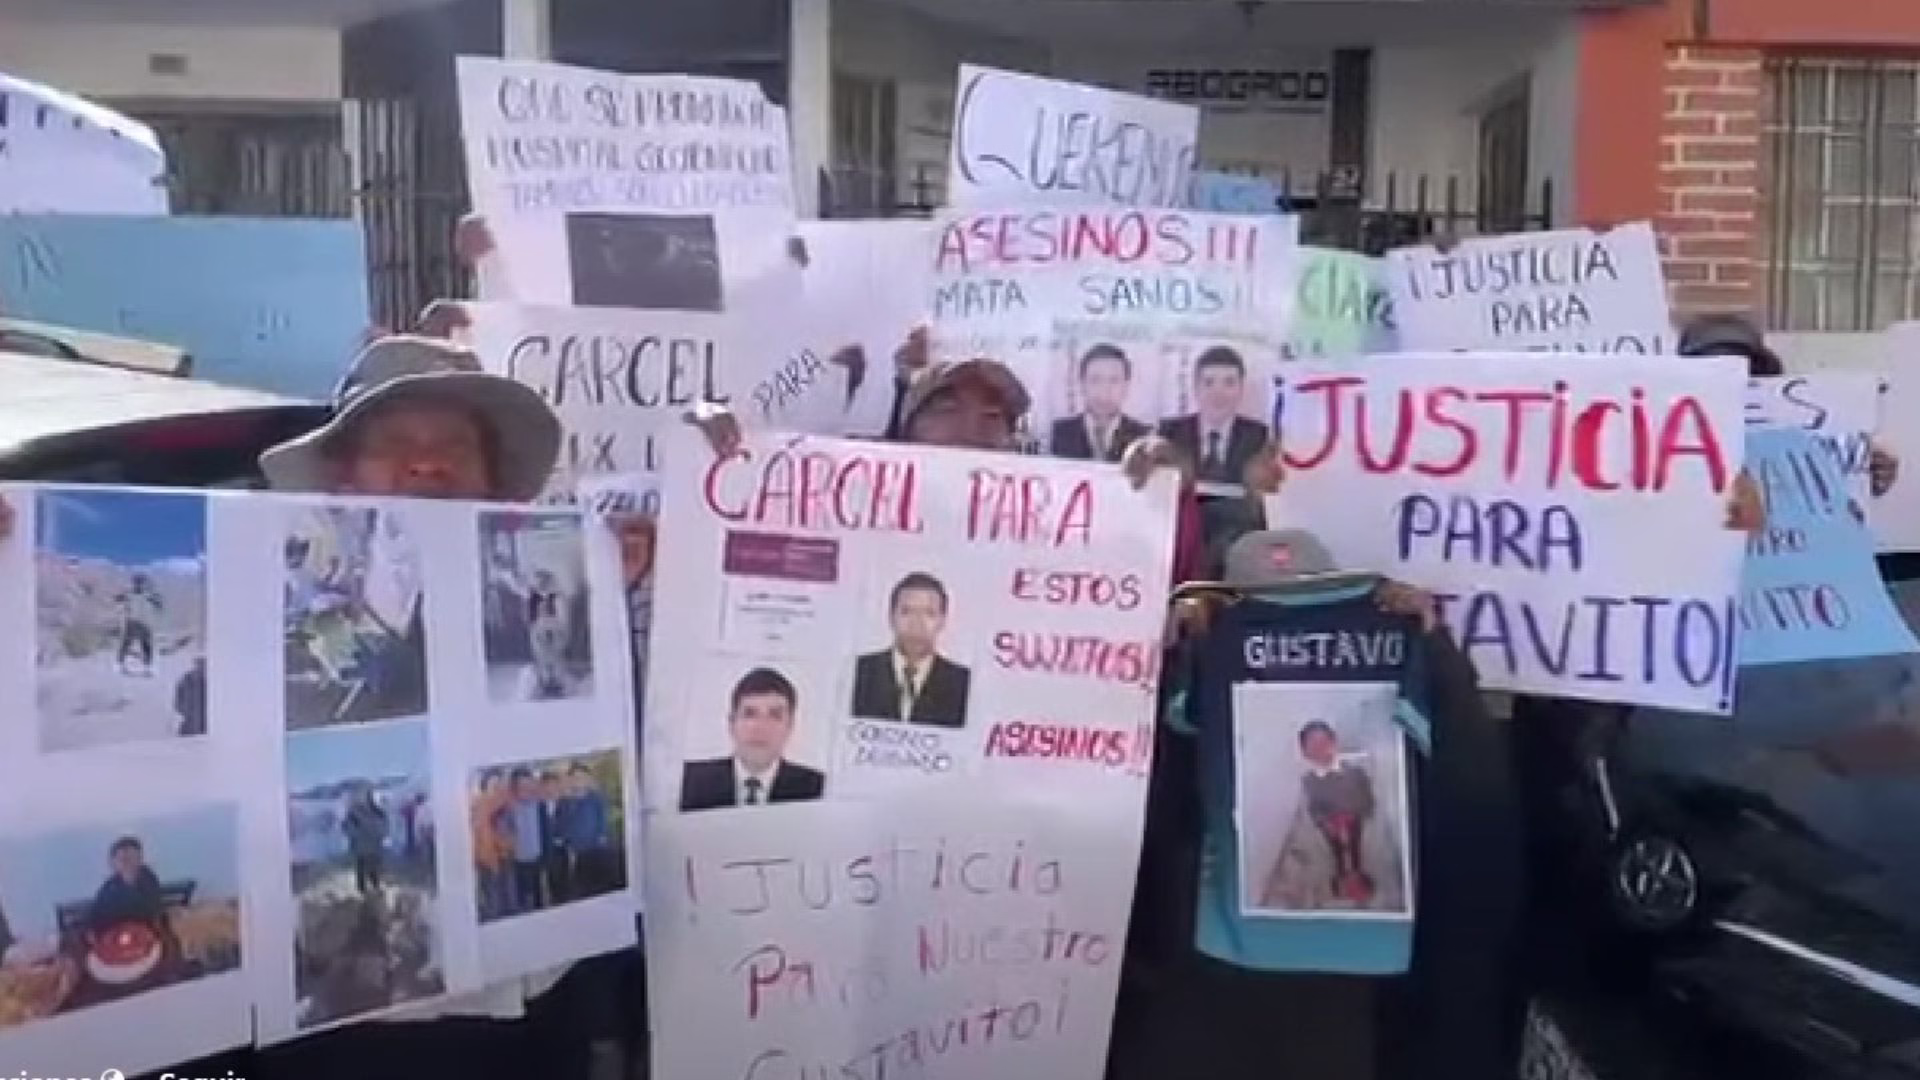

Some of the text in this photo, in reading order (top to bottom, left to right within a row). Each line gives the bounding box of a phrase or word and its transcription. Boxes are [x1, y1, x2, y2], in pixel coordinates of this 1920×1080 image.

[1491, 293, 1590, 337] PARA
[752, 346, 828, 413] PARA
[965, 468, 1094, 548] PARA
[1398, 494, 1583, 573] PARA
[1011, 567, 1142, 612] ESTOS
[1242, 628, 1405, 669] GUSTAVO
